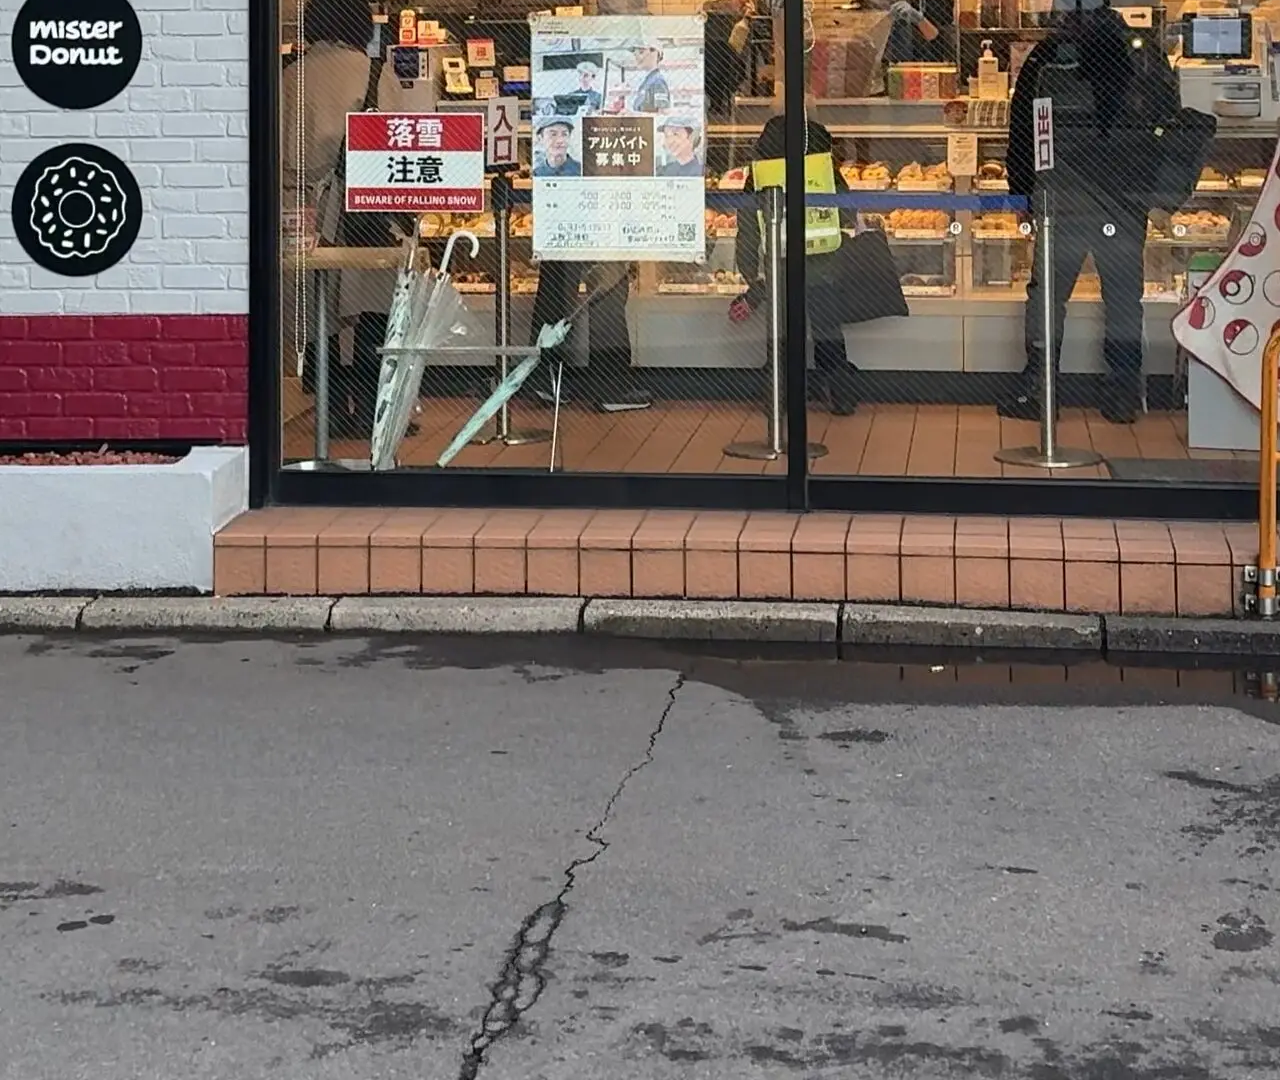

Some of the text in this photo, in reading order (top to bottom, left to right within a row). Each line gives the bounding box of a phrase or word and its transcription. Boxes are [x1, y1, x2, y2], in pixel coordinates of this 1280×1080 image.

[29, 44, 124, 65] Donut
[386, 117, 444, 148] 落雪
[493, 104, 514, 163] 入口
[588, 135, 648, 150] アルバイト
[1037, 104, 1051, 168] 出口
[387, 155, 444, 184] 注意
[595, 152, 641, 167] 募集中
[354, 195, 477, 205] BEWARE OF FALLING SNOW
